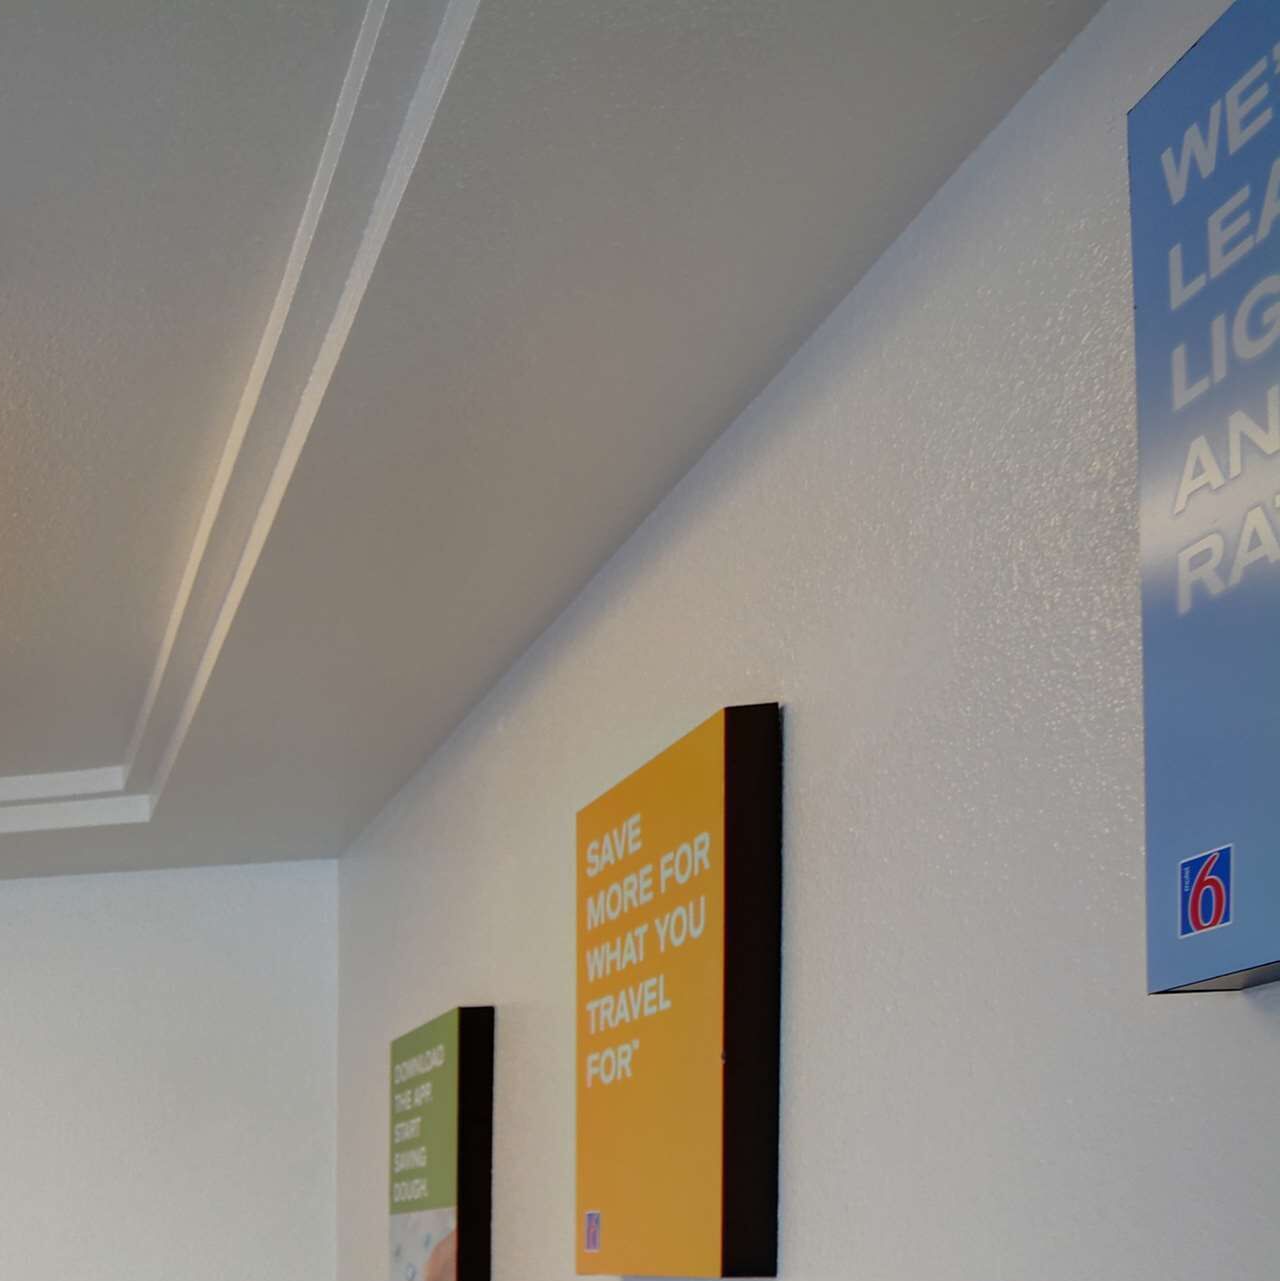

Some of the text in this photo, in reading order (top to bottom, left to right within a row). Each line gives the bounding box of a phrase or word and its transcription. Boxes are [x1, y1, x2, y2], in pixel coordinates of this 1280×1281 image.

[586, 813, 643, 878] SAVE
[587, 831, 711, 931] MORE FOR
[1188, 851, 1226, 934] 6
[586, 895, 706, 983] WHAT YOU
[586, 975, 672, 1035] TRAVEL
